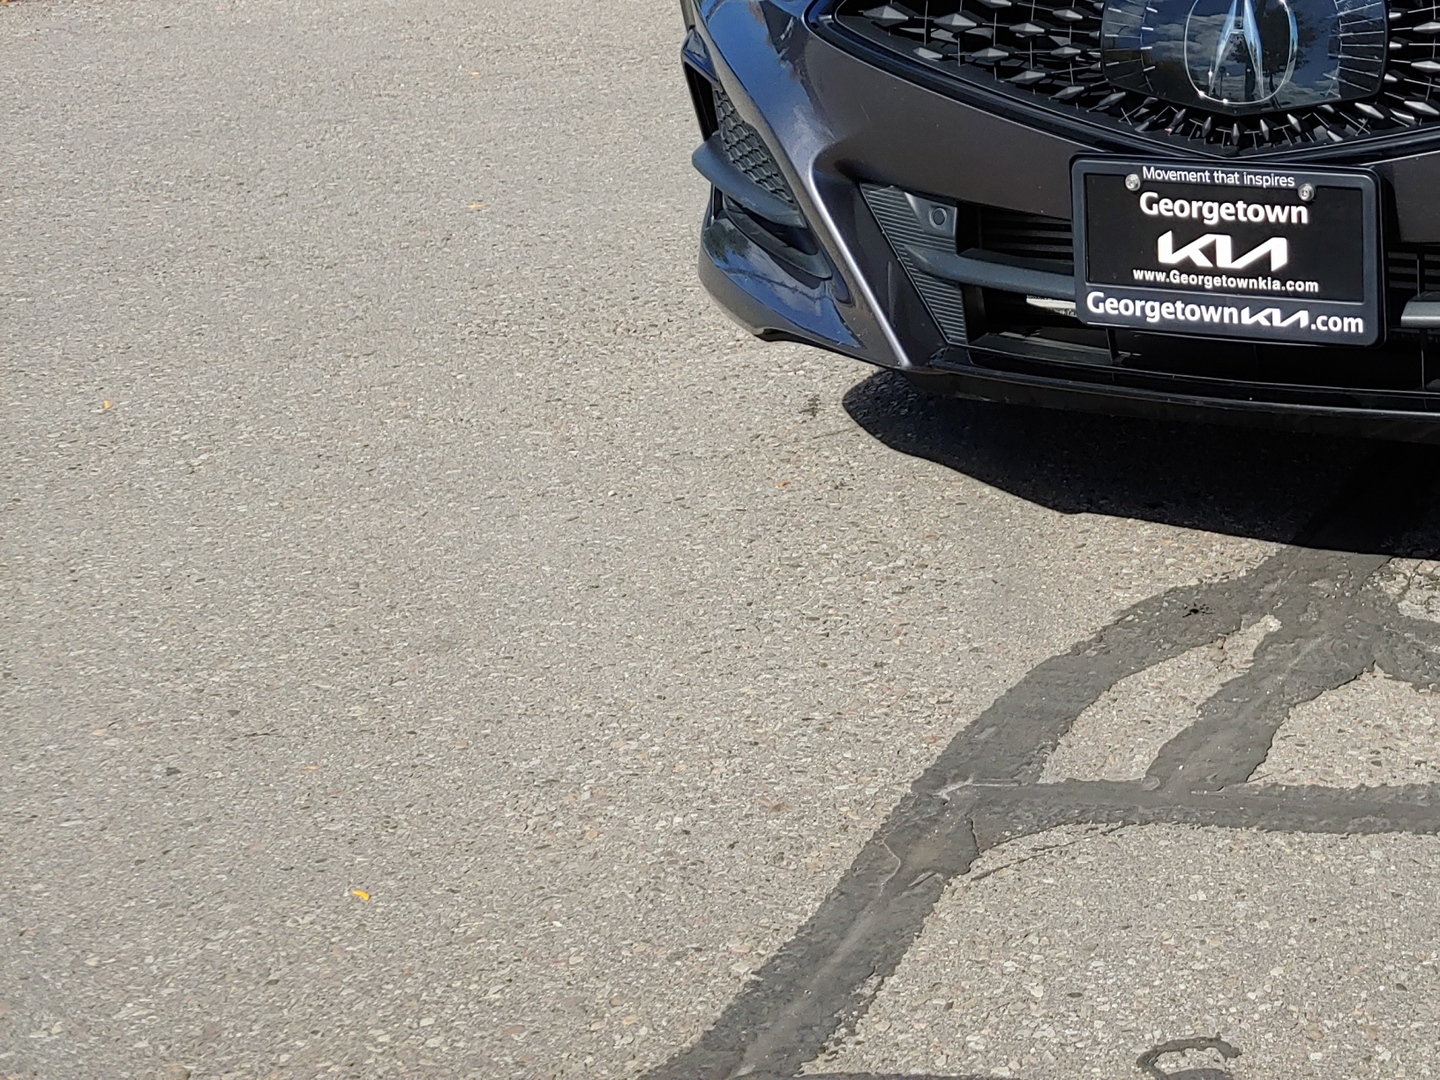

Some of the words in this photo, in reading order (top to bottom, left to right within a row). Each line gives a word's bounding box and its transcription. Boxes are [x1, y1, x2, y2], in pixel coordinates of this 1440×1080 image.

[1142, 166, 1210, 182] Movement
[1213, 170, 1239, 185] that
[1243, 172, 1295, 189] inspires
[1140, 191, 1308, 225] Georgetown
[1157, 230, 1288, 272] KIA
[1133, 268, 1319, 293] www.Georgetownkia.com
